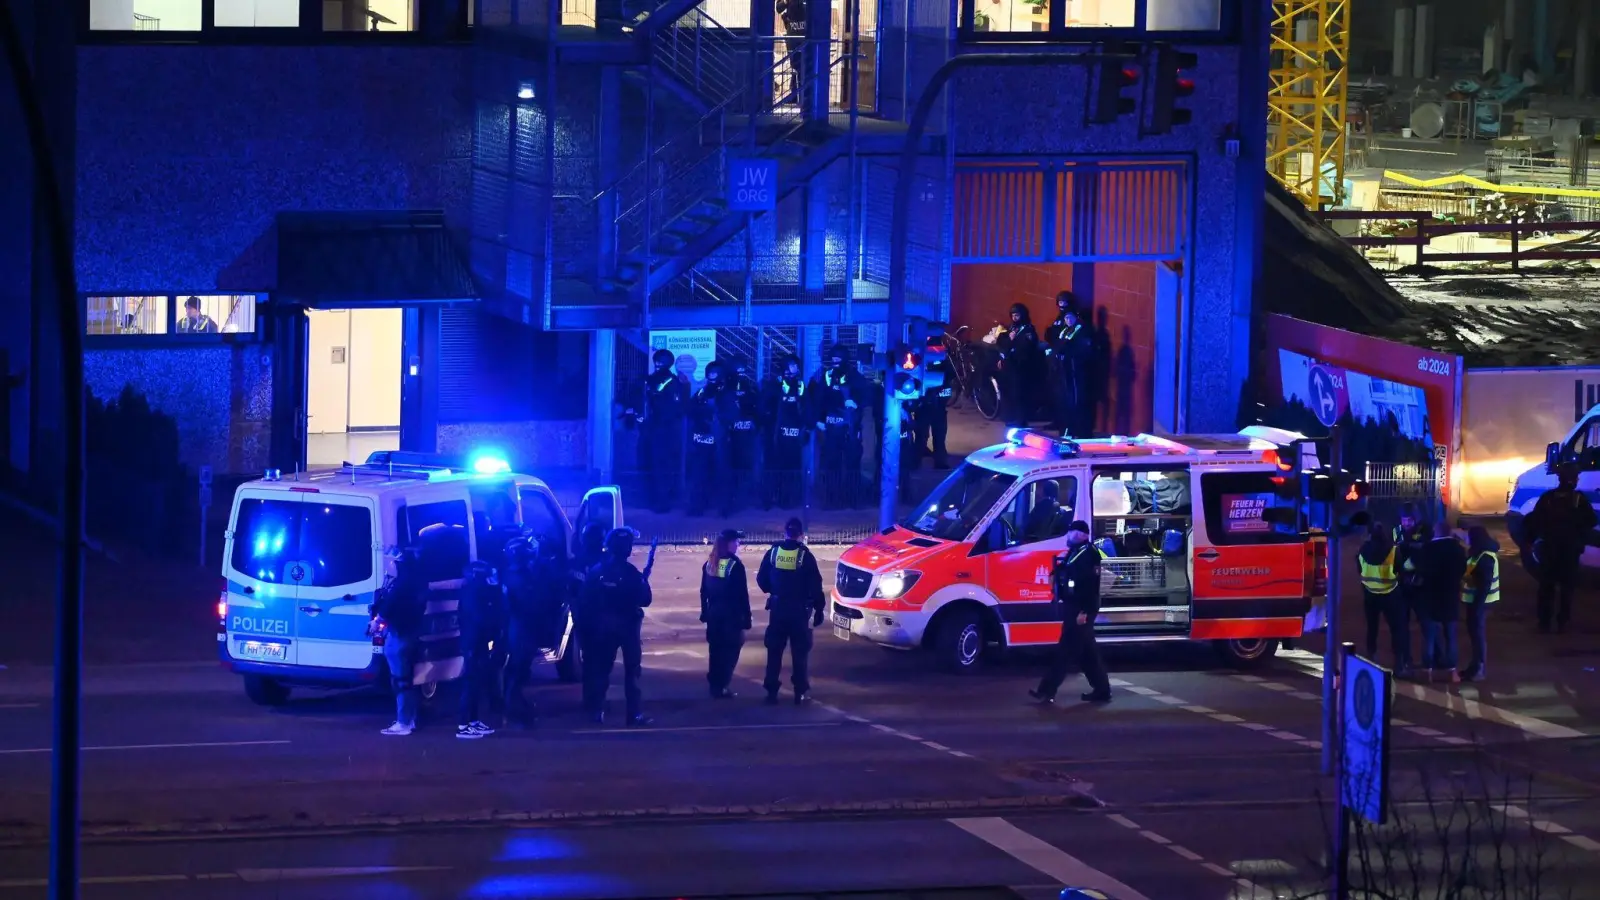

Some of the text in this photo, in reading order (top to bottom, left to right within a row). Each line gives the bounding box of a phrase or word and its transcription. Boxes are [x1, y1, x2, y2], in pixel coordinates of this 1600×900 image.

[790, 21, 806, 31] POLIZ
[738, 167, 768, 186] JW
[1418, 357, 1450, 376] ab 2024
[1231, 500, 1254, 508] FEUER
[1229, 508, 1263, 519] HERZEN
[777, 555, 796, 563] POLIZEI
[1211, 567, 1270, 576] FEUERWEHR
[233, 616, 289, 634] POLIZEI
